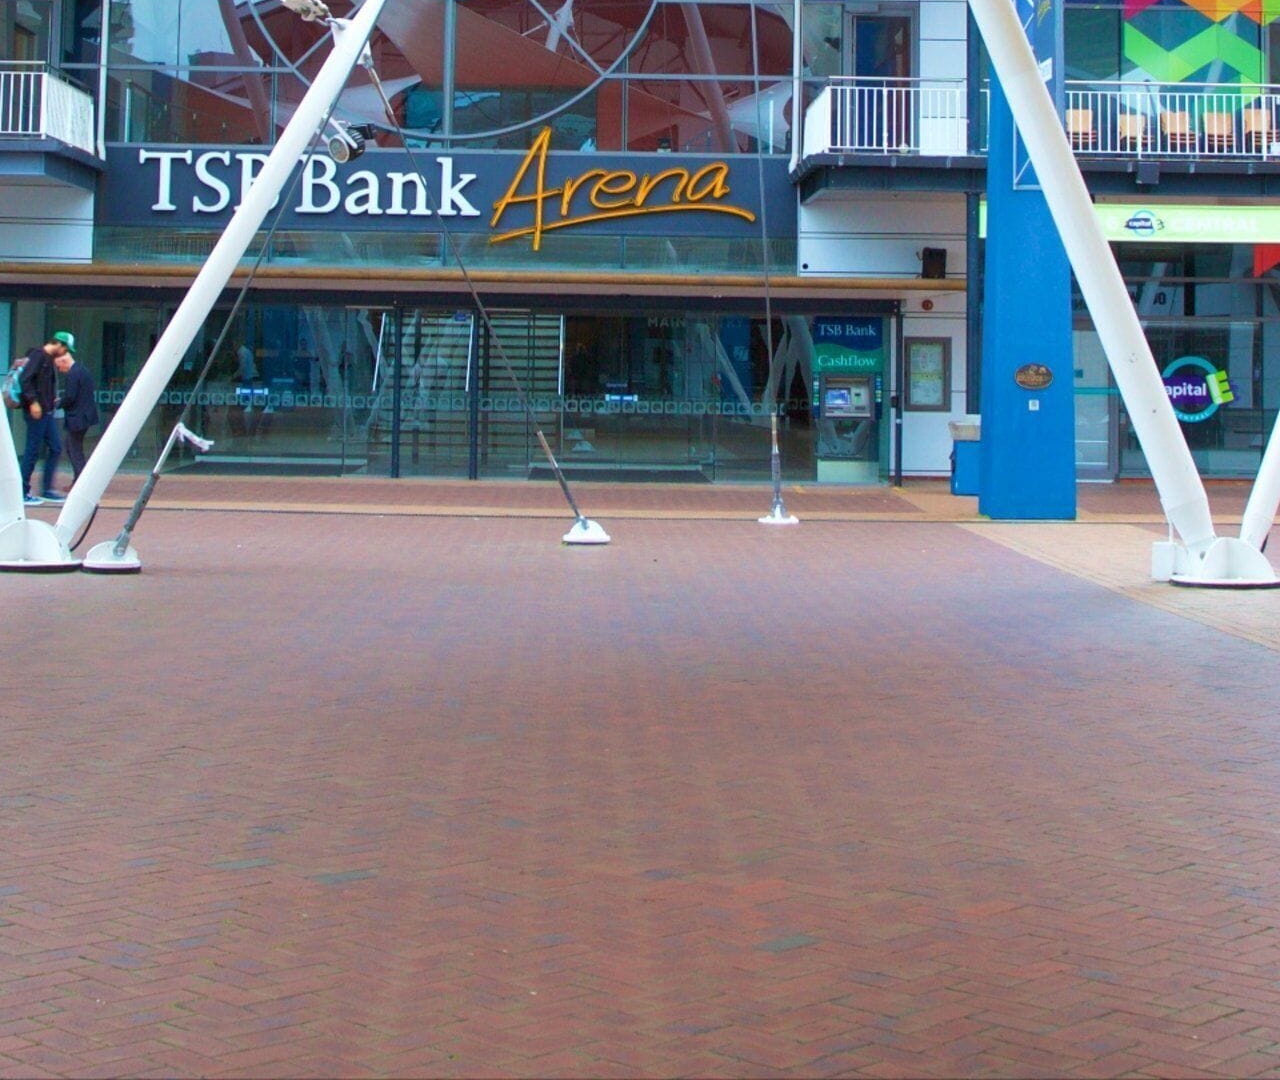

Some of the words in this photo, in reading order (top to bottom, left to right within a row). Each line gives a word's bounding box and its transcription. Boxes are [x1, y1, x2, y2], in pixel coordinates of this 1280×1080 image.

[294, 153, 481, 218] Bank
[491, 126, 754, 250] Arena
[1170, 216, 1258, 232] CENTRAL
[819, 324, 842, 336] TSB
[846, 324, 876, 336] Bank
[818, 354, 877, 366] Cashflow
[1164, 382, 1207, 399] apital
